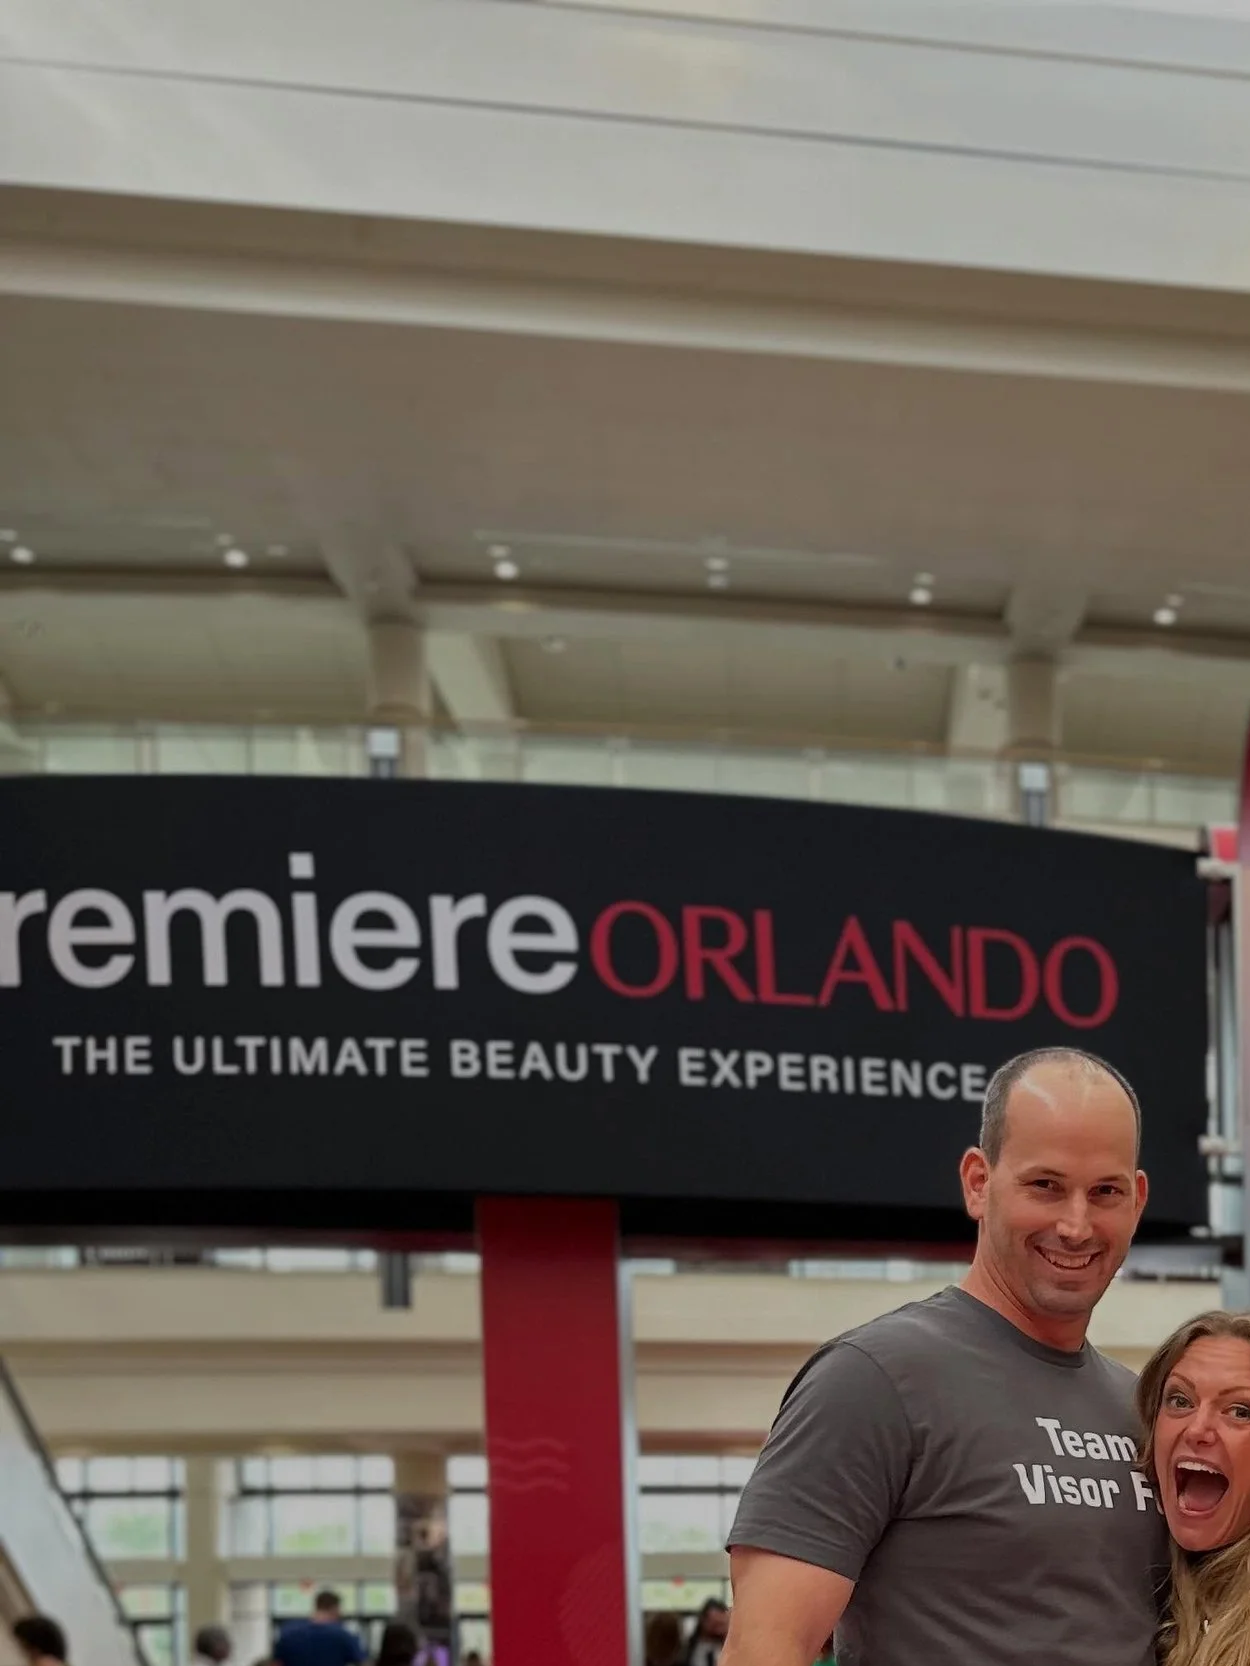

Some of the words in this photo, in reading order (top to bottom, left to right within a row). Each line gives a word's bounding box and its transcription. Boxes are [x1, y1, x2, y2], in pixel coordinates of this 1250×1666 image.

[0, 852, 578, 994] remiere
[591, 900, 1119, 1027] ORLANDO
[54, 1036, 154, 1075] THE
[172, 1036, 429, 1077] ULTIMATE
[450, 1041, 659, 1084] BEAUTY
[678, 1047, 988, 1101] EXPERIENCE
[1035, 1417, 1138, 1463] Team
[1012, 1463, 1120, 1509] Visor
